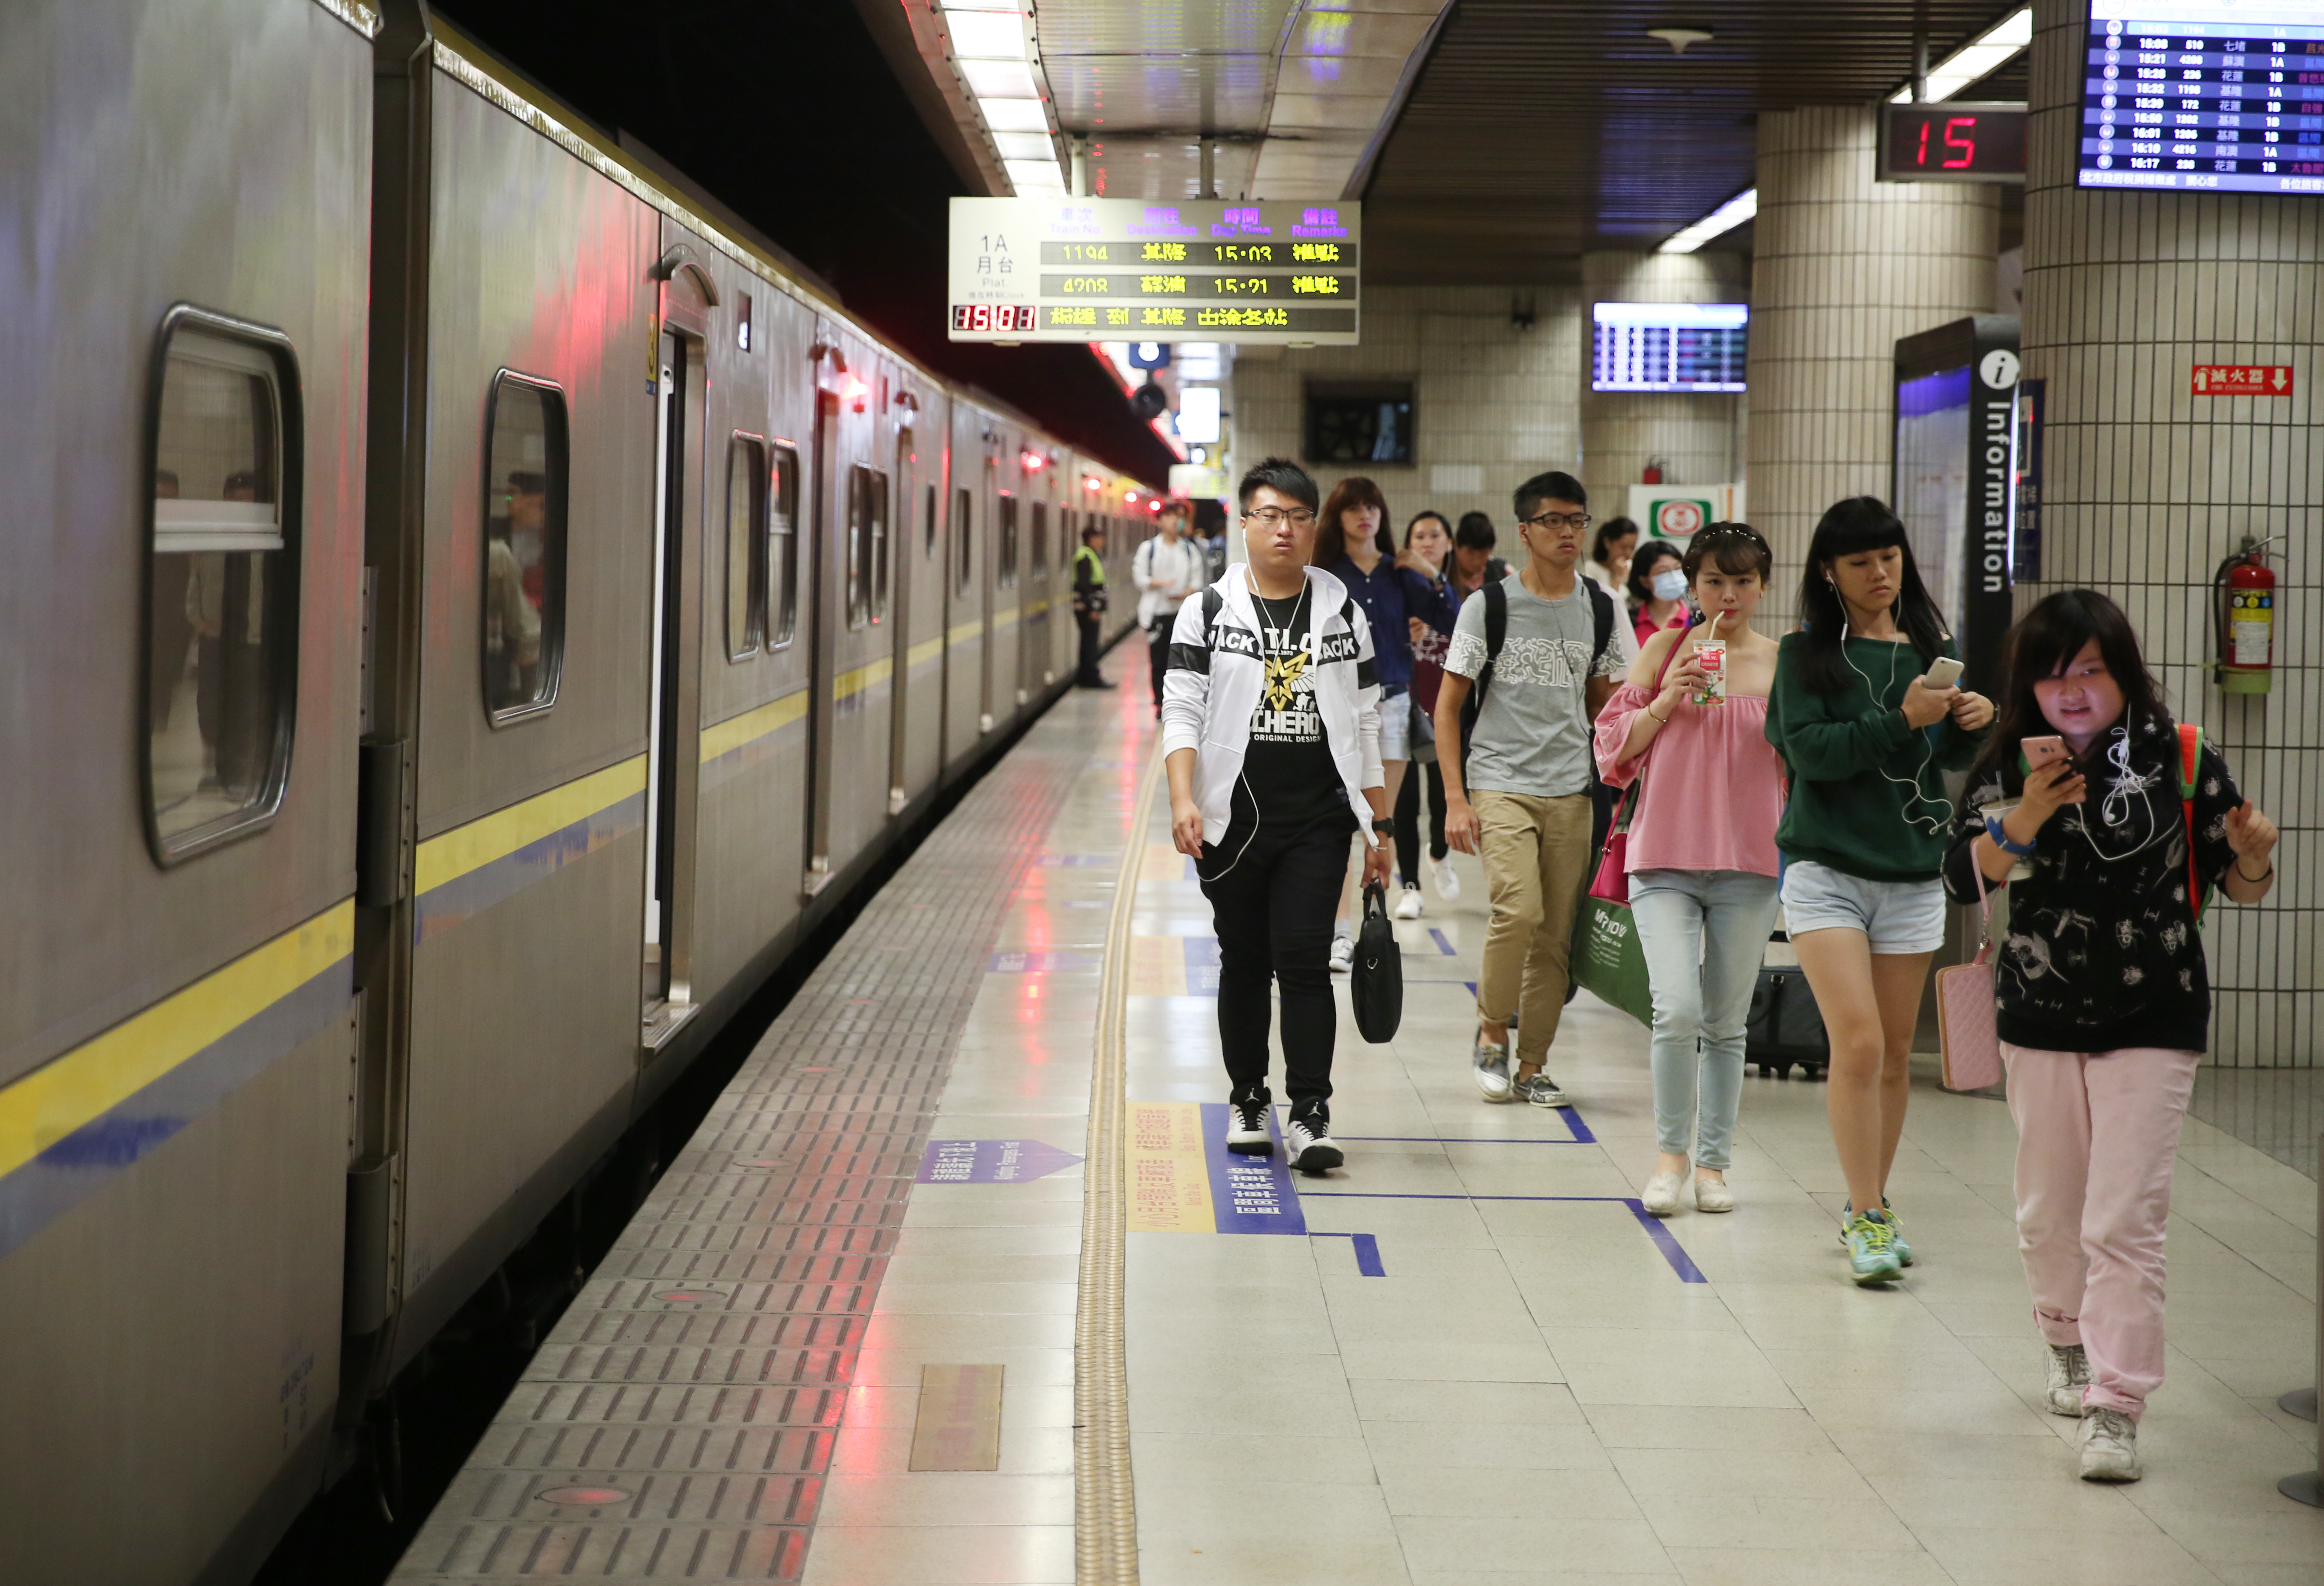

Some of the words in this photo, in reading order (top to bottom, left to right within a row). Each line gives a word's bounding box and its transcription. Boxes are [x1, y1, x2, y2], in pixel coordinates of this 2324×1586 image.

[2141, 23, 2169, 34] 15:03
[2183, 24, 2205, 35] 1194
[2273, 27, 2286, 37] 1A
[2139, 38, 2169, 50] 15:08
[2185, 40, 2204, 50] 510
[2271, 41, 2286, 53] 1B
[2138, 53, 2166, 64] 15:21
[2179, 54, 2203, 65] 4208
[2270, 57, 2284, 68] 1A
[2137, 68, 2166, 79] 15:28
[2183, 69, 2201, 80] 236
[2269, 72, 2283, 82] 1B
[2136, 83, 2165, 94] 15:32
[2268, 86, 2283, 98] 1A
[2135, 97, 2164, 109] 15:39
[2182, 100, 2199, 109] 172
[2267, 101, 2281, 112] 1B
[2134, 112, 2163, 124] 15:50
[2175, 113, 2199, 124] 1202
[2265, 116, 2280, 127] 1B
[2133, 127, 2161, 138] 16:01
[2174, 129, 2198, 139] 1206
[2264, 131, 2279, 142] 1B
[1917, 117, 1977, 168] 15
[2131, 142, 2161, 154] 16:10
[2172, 144, 2197, 154] 4216
[2263, 146, 2278, 157] 1A
[2130, 158, 2160, 169] 16:17
[2176, 159, 2195, 169] 238
[2262, 161, 2276, 172] 1B
[1061, 207, 1093, 222] 車次
[1223, 207, 1259, 225] 時間
[1303, 208, 1339, 226] 備註
[1050, 223, 1080, 234] Train
[1083, 224, 1104, 235] No.
[1126, 223, 1198, 236] Destination
[1240, 224, 1272, 236] Time
[1291, 225, 1348, 237] Remarks
[980, 234, 1008, 252] 1A
[977, 256, 1013, 274] 月台
[962, 304, 1035, 331] 15:01
[2211, 368, 2264, 384] 滅火器
[1983, 401, 2012, 593] Information
[1254, 734, 1293, 742] ORIGINAL
[1226, 1167, 1281, 1215] 區間車候車線
